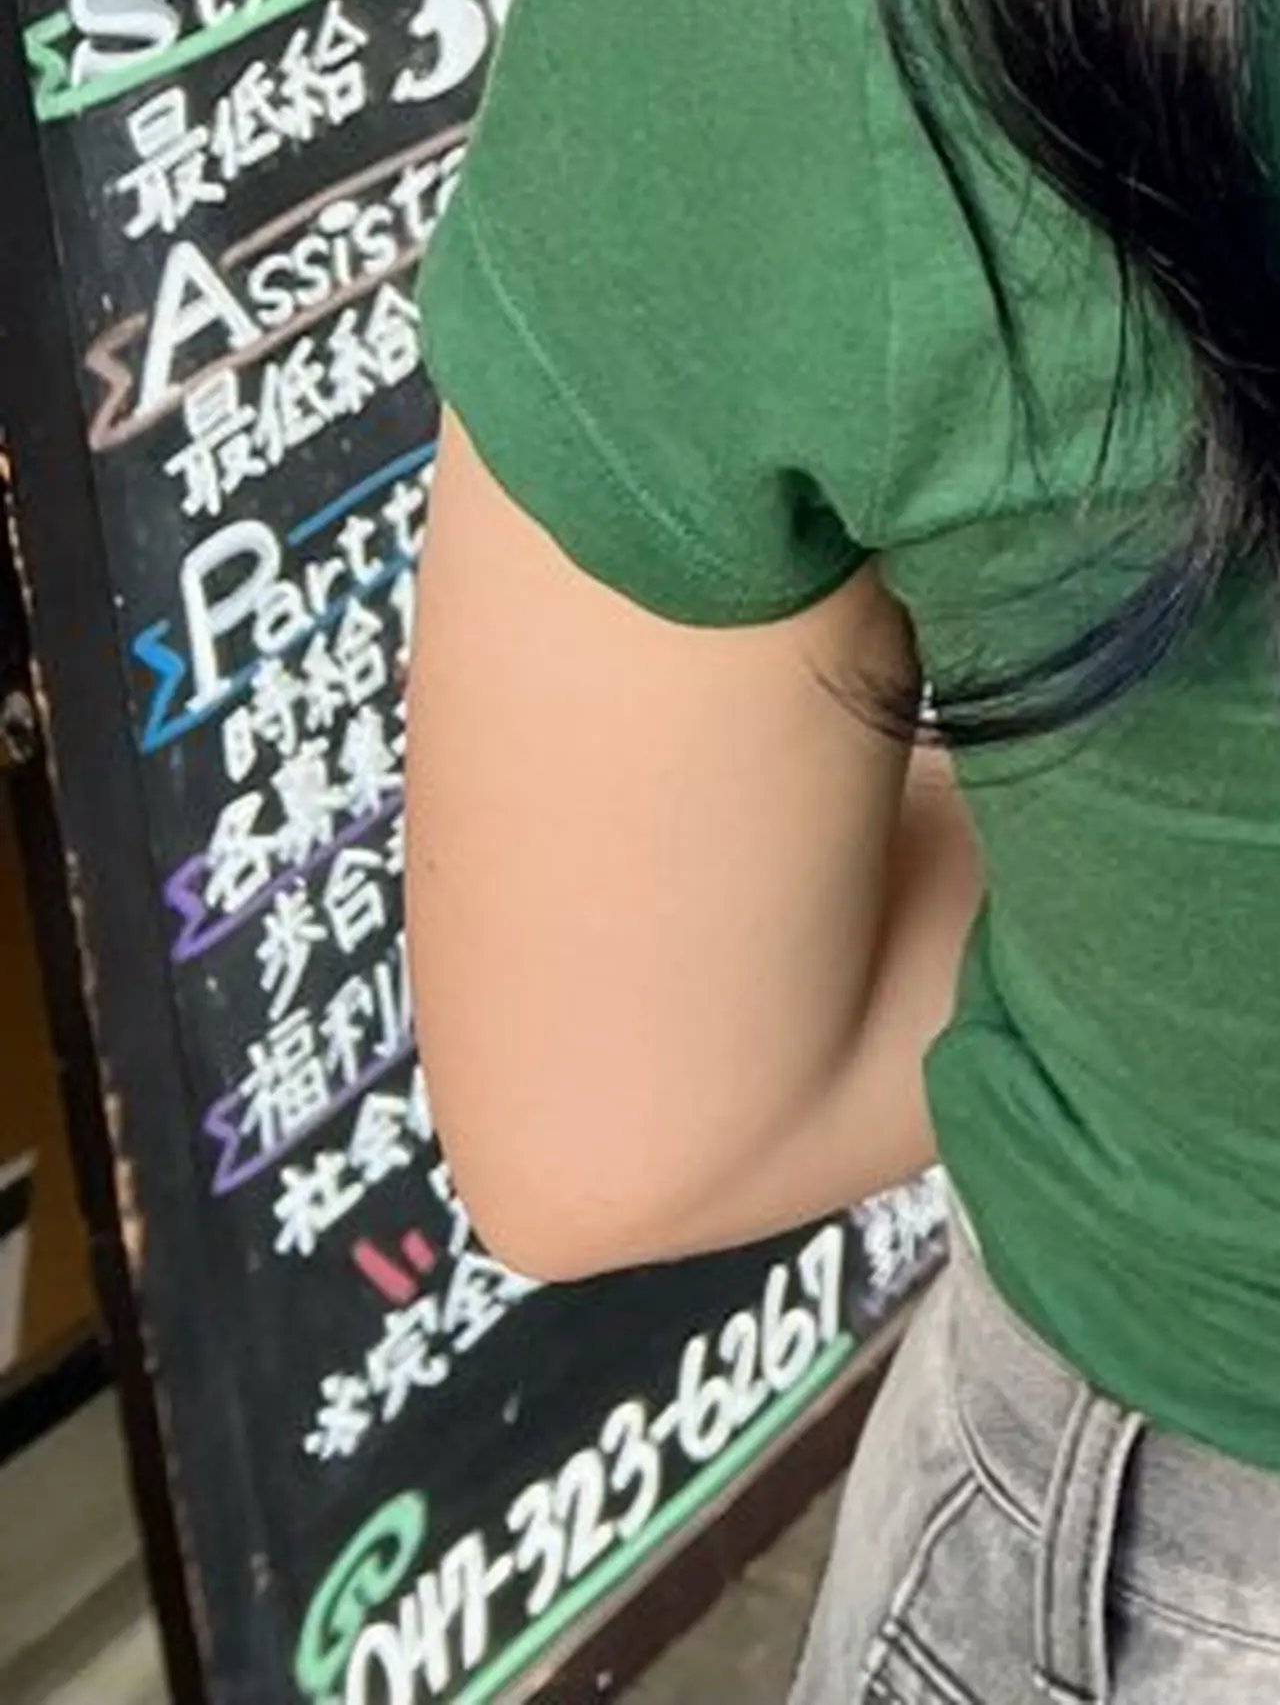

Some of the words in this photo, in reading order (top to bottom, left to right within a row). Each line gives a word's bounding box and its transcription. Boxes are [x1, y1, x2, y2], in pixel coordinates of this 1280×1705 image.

[180, 463, 437, 713] Partt
[255, 813, 404, 1021] 歩合
[236, 929, 412, 1149] 福利
[345, 1223, 844, 1705] 047-323-6267
